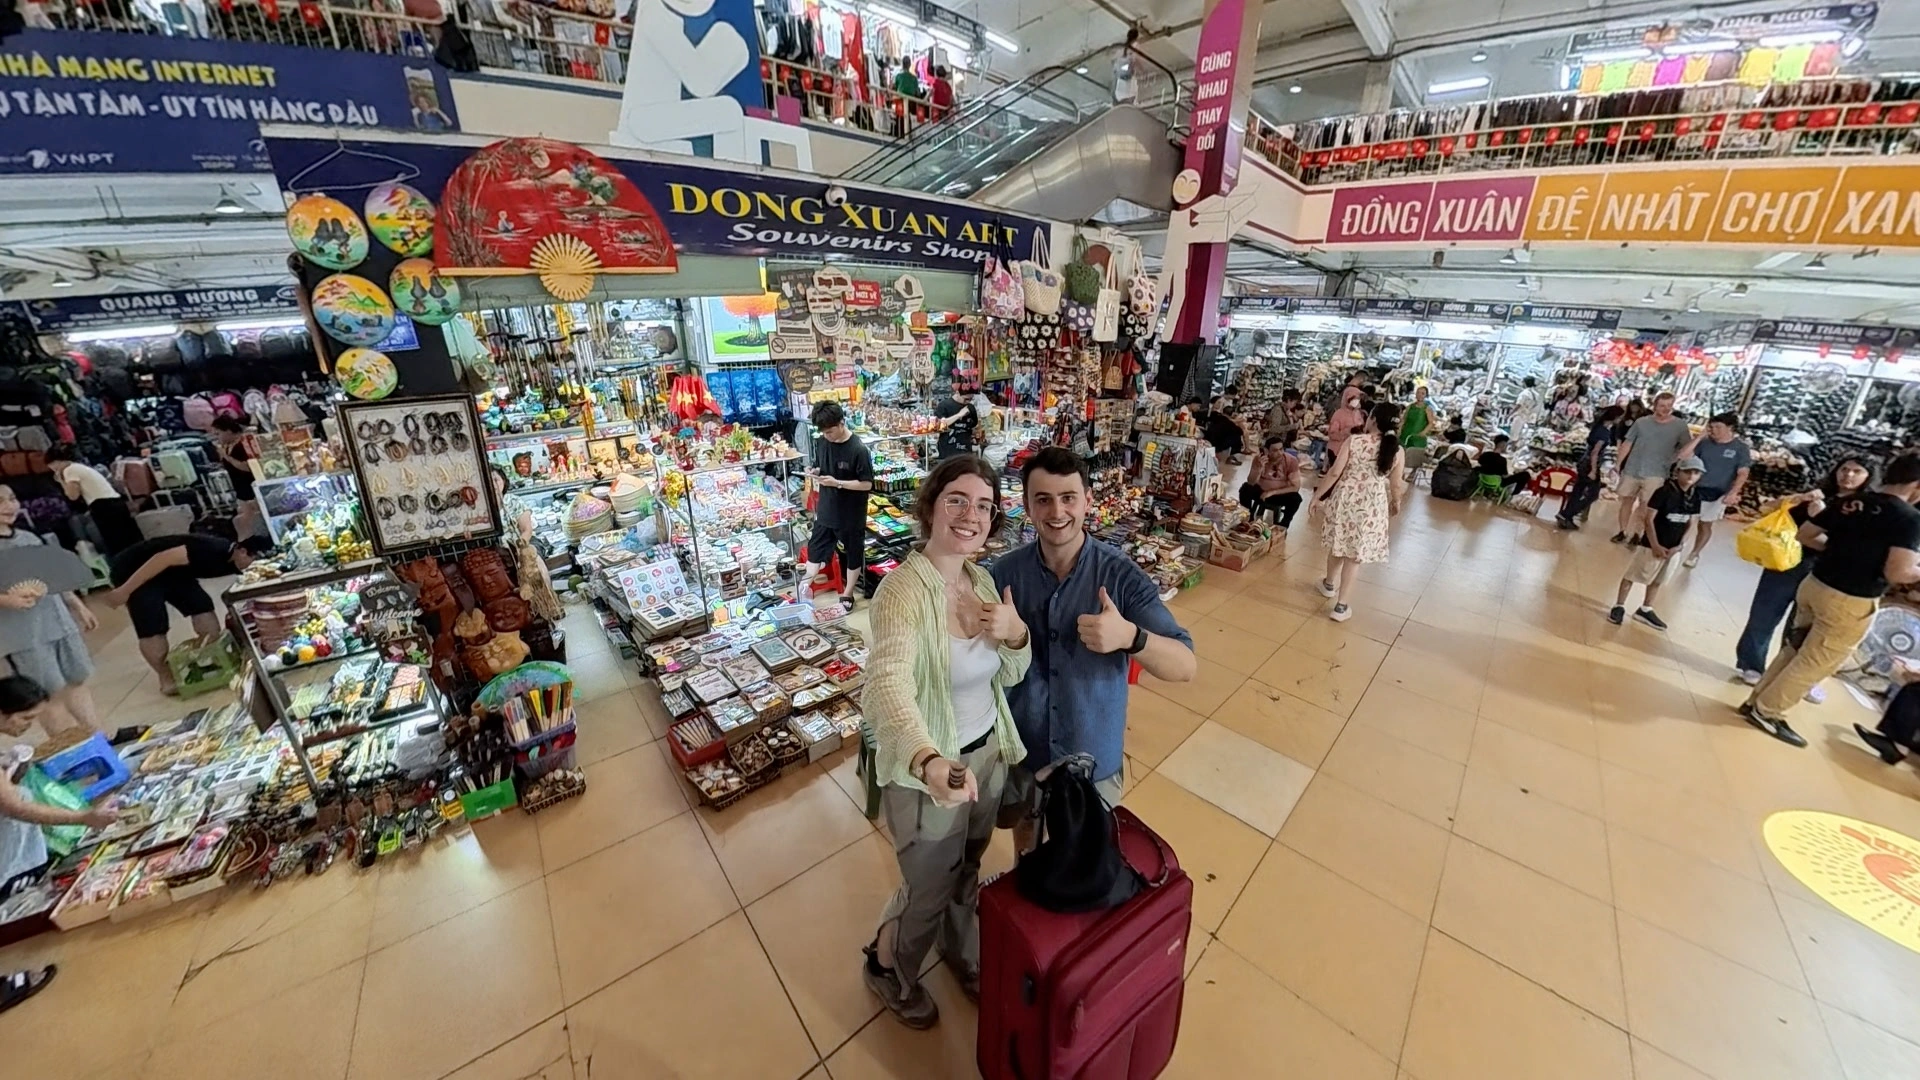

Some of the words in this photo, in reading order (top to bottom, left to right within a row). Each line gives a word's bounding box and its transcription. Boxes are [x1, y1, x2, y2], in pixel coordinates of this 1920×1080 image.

[56, 54, 150, 82] MẠNG
[151, 59, 276, 87] INTERNET
[11, 86, 78, 118] TẬN
[161, 95, 198, 118] UY
[201, 94, 248, 120] TÍN
[250, 96, 326, 122] HÀNG
[1197, 79, 1229, 101] NHAU
[1196, 106, 1224, 127] THAY
[53, 152, 115, 165] VNPT
[664, 181, 826, 225] DONG
[838, 202, 950, 239] XUAN
[1341, 194, 1422, 236] ĐỒNG
[1432, 189, 1523, 233] XUÂN
[1536, 186, 1590, 238] ĐỆ
[1600, 182, 1711, 232] NHẤT
[1722, 186, 1825, 241] CHỢ
[727, 222, 914, 254] Souvenirs
[921, 240, 991, 264] Shop
[100, 293, 178, 311] QUANG
